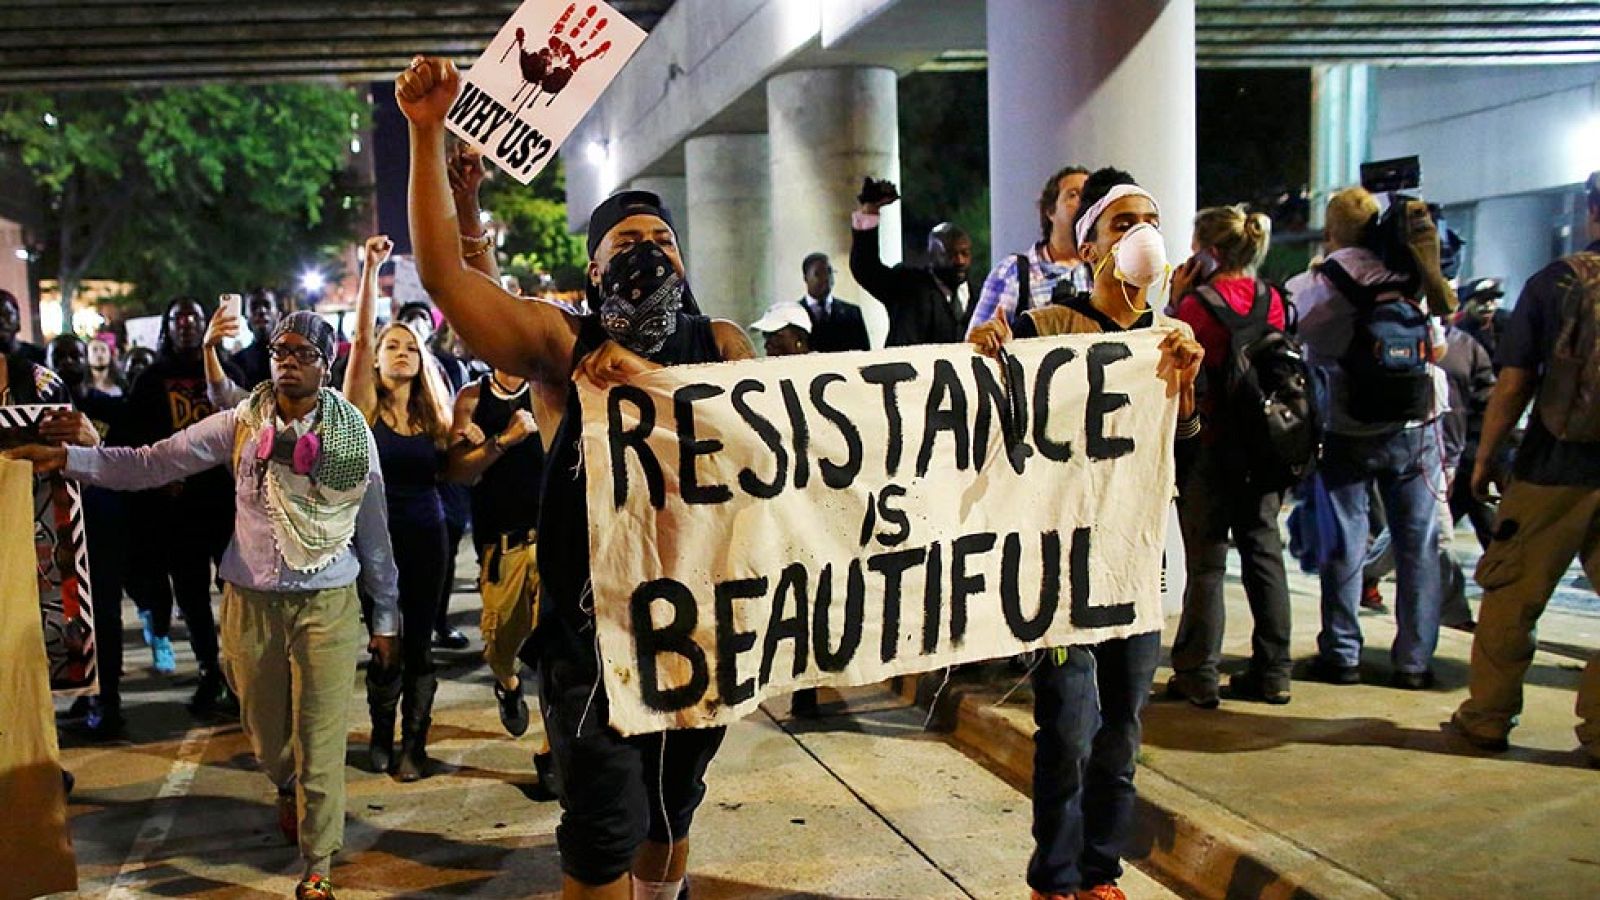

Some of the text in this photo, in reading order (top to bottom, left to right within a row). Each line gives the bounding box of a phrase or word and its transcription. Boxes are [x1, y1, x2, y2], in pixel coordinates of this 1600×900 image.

[447, 81, 552, 175] WHY US?
[608, 342, 1136, 511] RESISTANCE
[860, 484, 911, 547] IS
[631, 527, 1136, 713] BEAUTIFUL
